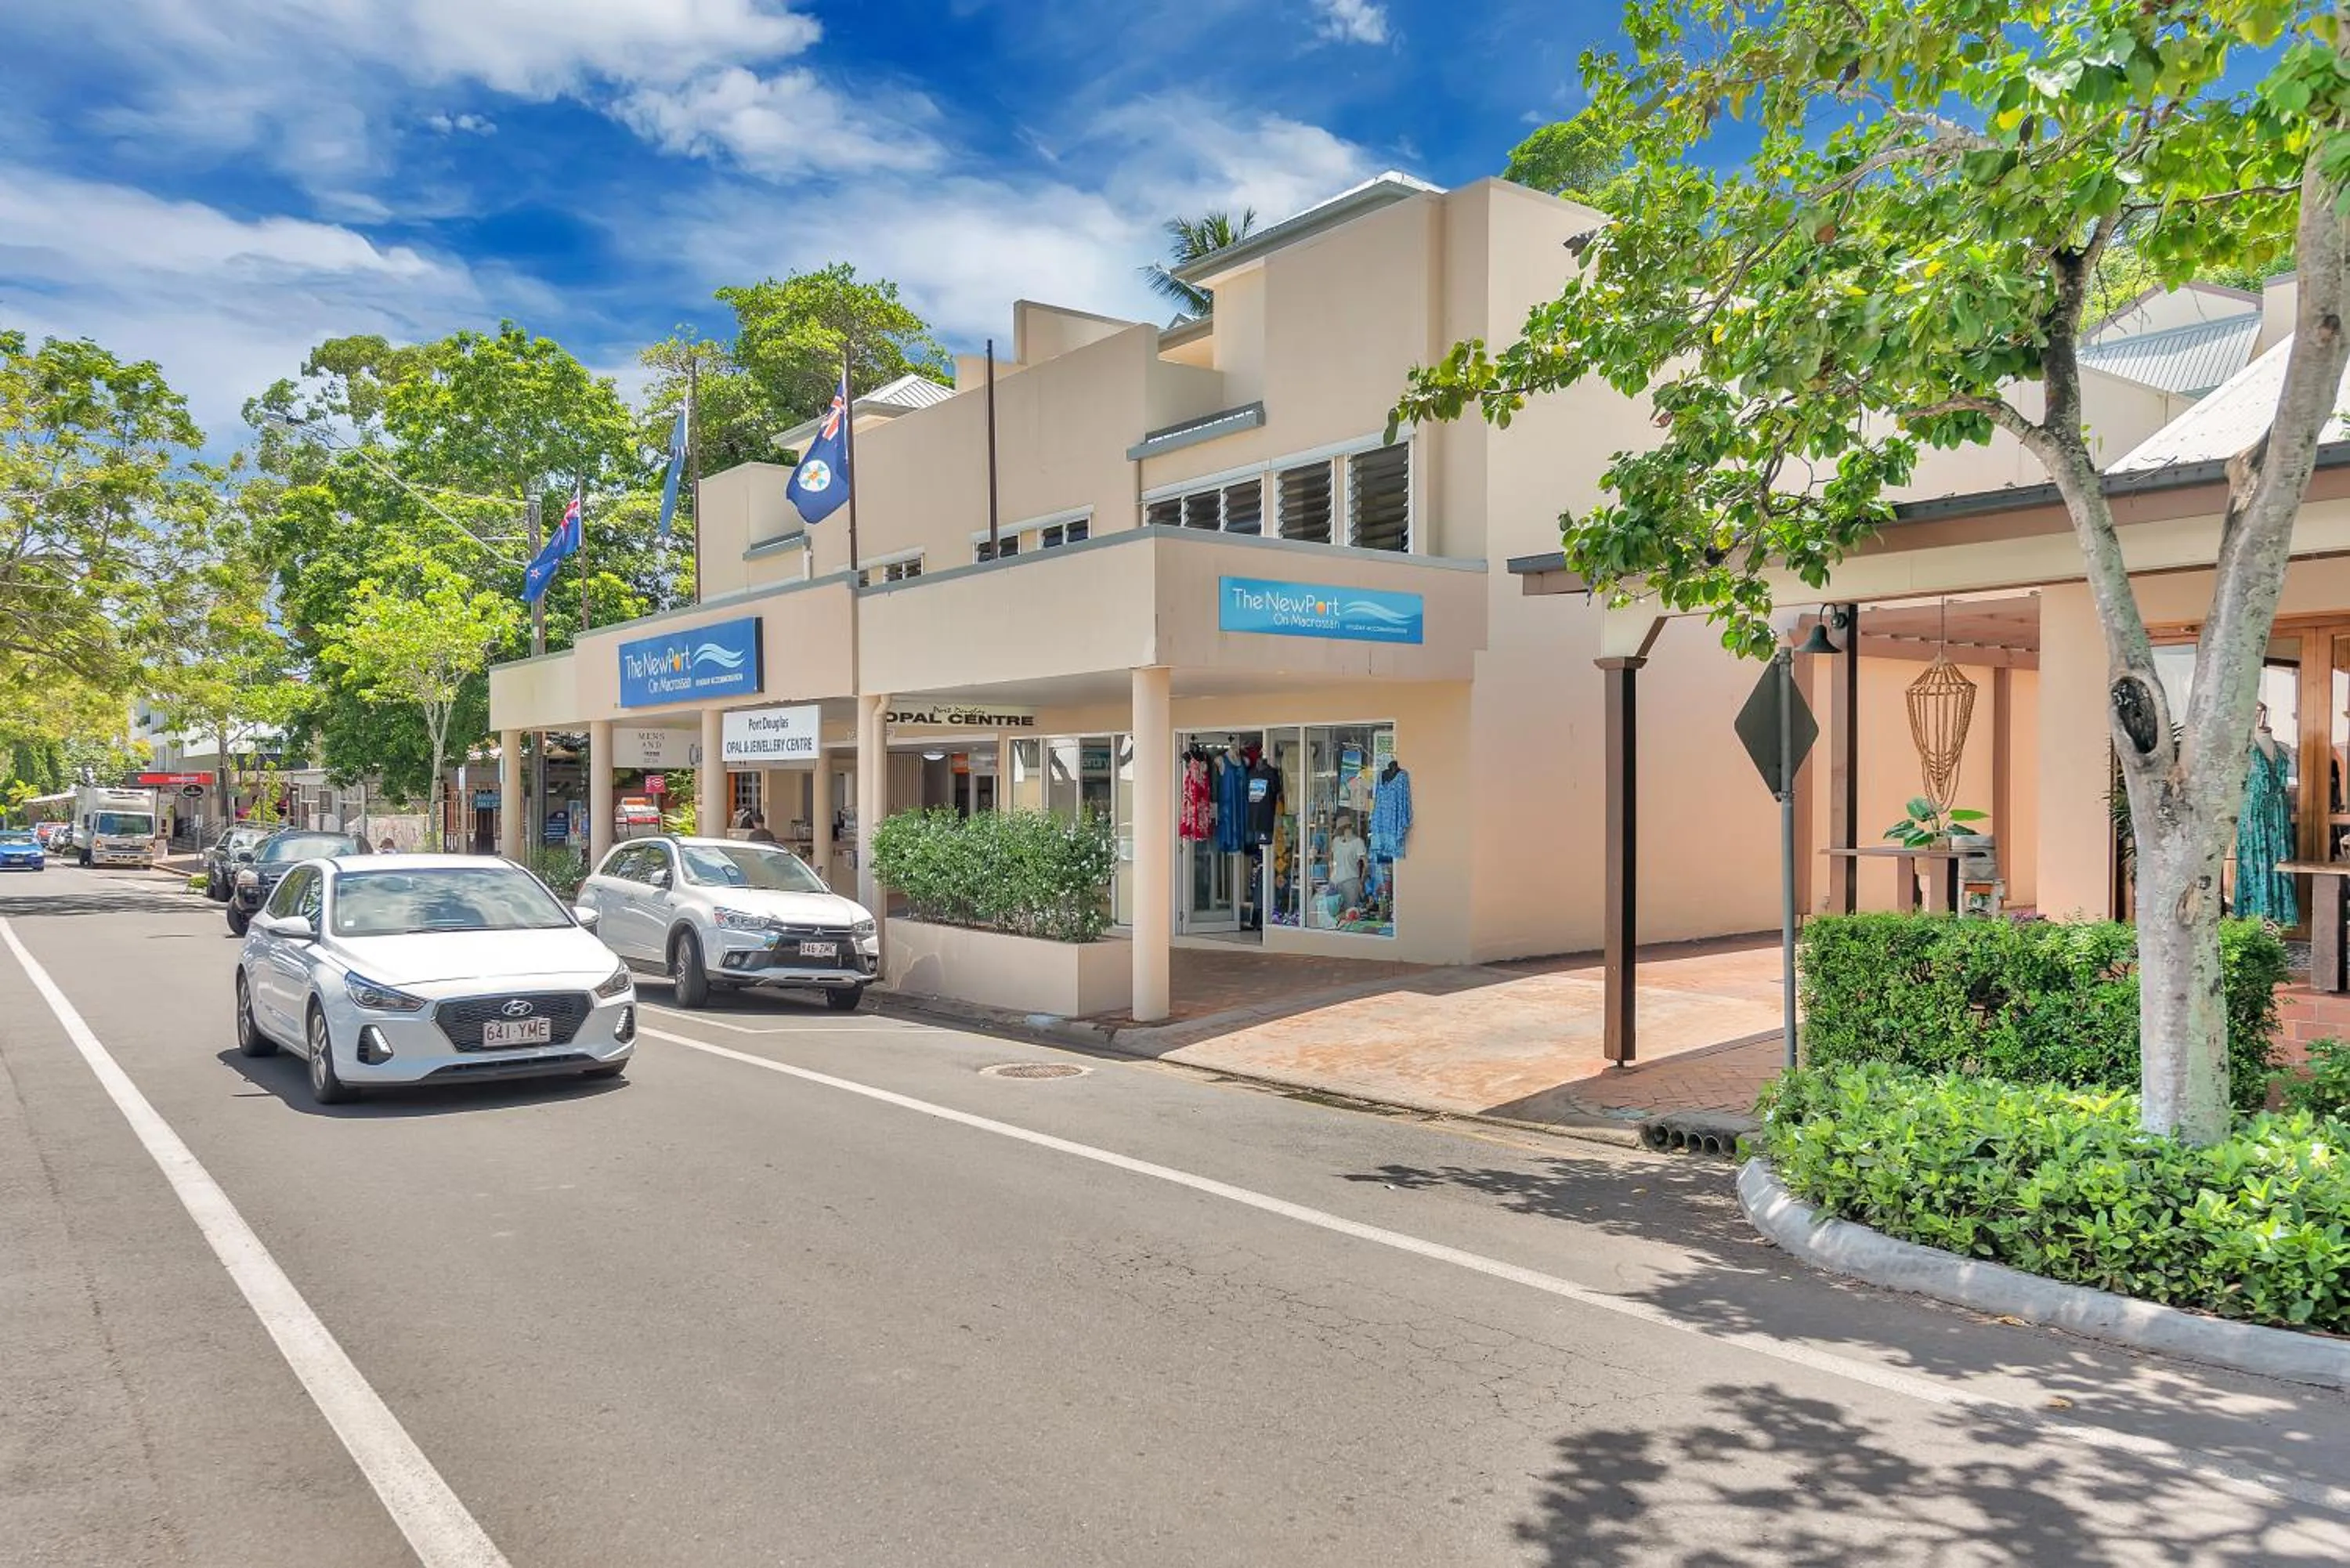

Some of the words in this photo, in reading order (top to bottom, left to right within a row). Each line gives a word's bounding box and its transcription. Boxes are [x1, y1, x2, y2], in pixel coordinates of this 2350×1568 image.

[1232, 588, 1264, 610] The
[1273, 612, 1289, 627] On
[624, 655, 643, 681] The
[748, 717, 761, 732] Port
[762, 716, 790, 732] Douglas
[886, 711, 942, 724] OPAL
[948, 714, 1034, 726] CENTRE
[726, 740, 743, 754] OPAL
[750, 739, 785, 753] JEWELLERY
[786, 737, 813, 752] CENTRE
